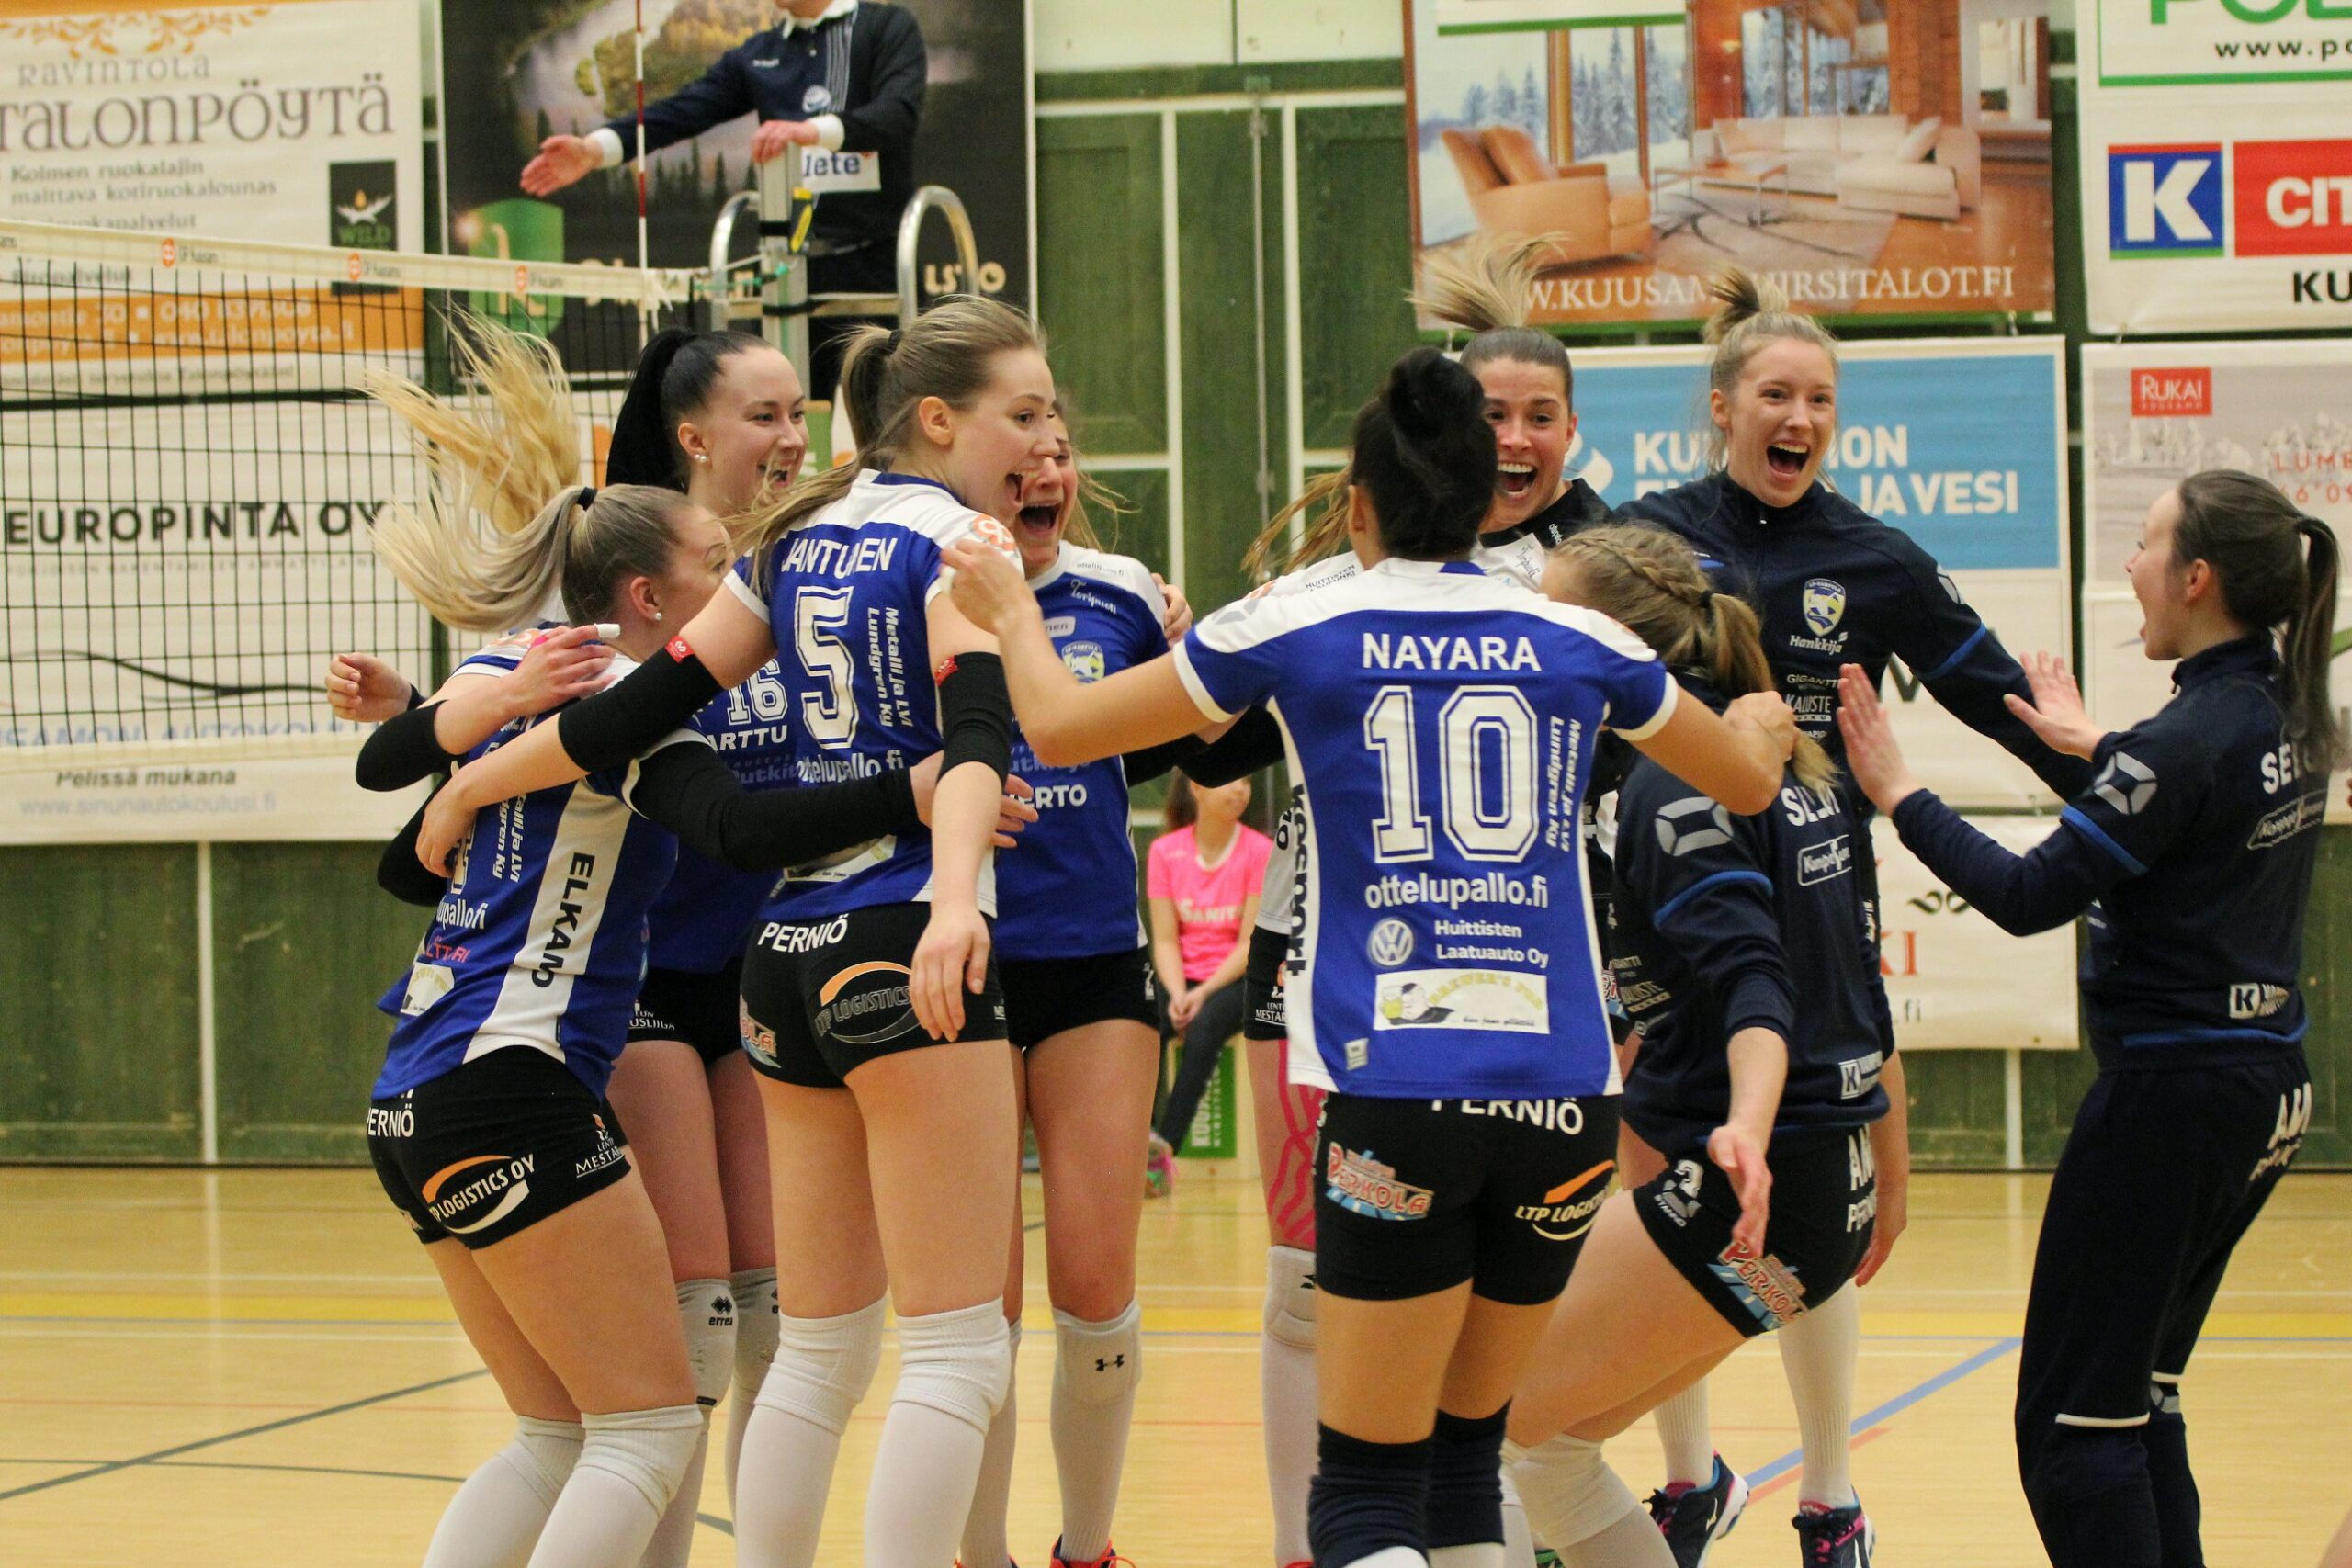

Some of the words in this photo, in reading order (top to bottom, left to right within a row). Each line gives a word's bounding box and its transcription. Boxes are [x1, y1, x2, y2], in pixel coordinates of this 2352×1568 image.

[2124, 160, 2213, 242] K
[1911, 469, 2018, 514] VESI
[6, 502, 300, 545] EUROPINTA
[1363, 632, 1543, 671] NAYARA
[1790, 635, 1842, 655] Hankkija
[794, 585, 859, 750] 5
[1786, 673, 1838, 689] GIGANTT
[727, 658, 788, 726] 16
[146, 767, 236, 787] mukana
[1363, 685, 1539, 864] 10
[1365, 873, 1548, 910] ottelupallo.fi
[757, 913, 849, 953] PERNIÖ
[1434, 919, 1522, 938] Huittisten
[1437, 943, 1525, 963] Laatuauto
[1527, 946, 1549, 968] Oy
[438, 1169, 509, 1223] LOGISTICS
[511, 1154, 536, 1179] OY
[1328, 1141, 1434, 1218] PERKOLA
[1515, 1205, 1548, 1223] LTP
